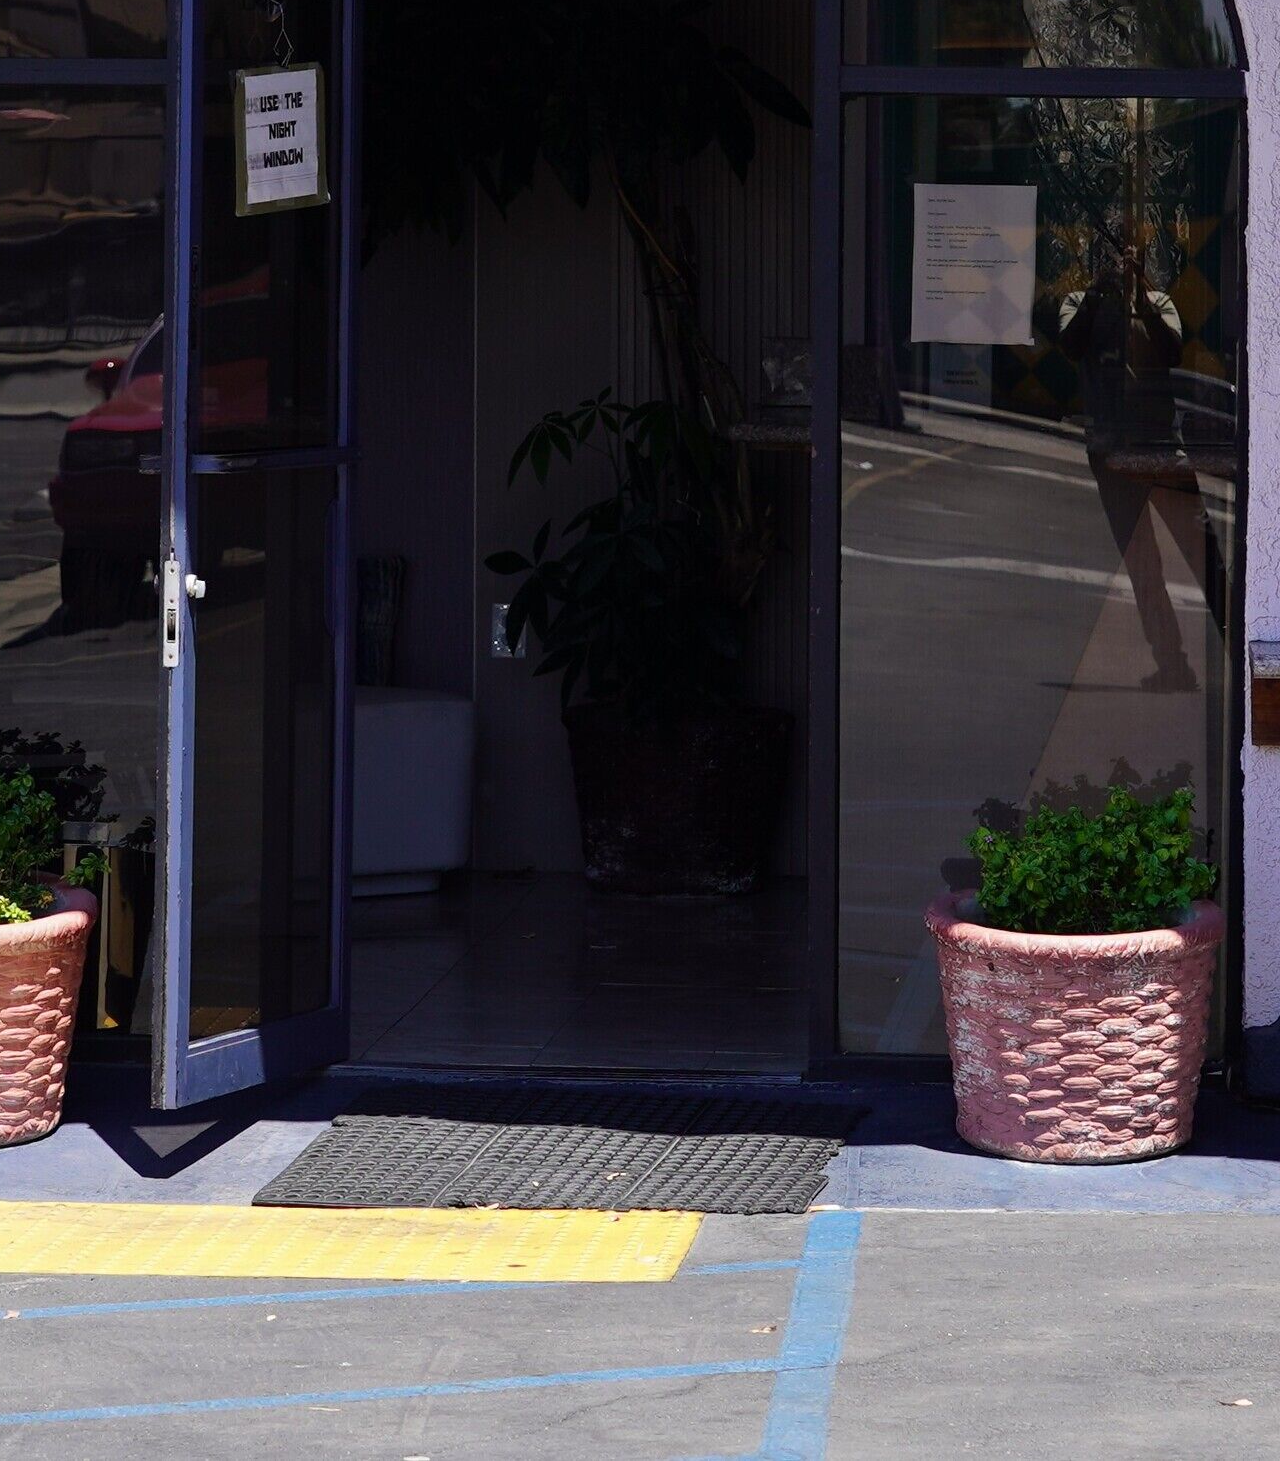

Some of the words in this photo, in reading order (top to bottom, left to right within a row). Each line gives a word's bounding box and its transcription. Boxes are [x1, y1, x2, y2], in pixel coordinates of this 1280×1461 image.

[260, 94, 279, 112] USE
[284, 91, 303, 110] THE
[268, 120, 297, 140] NIGHT
[263, 147, 303, 169] WINDOW
